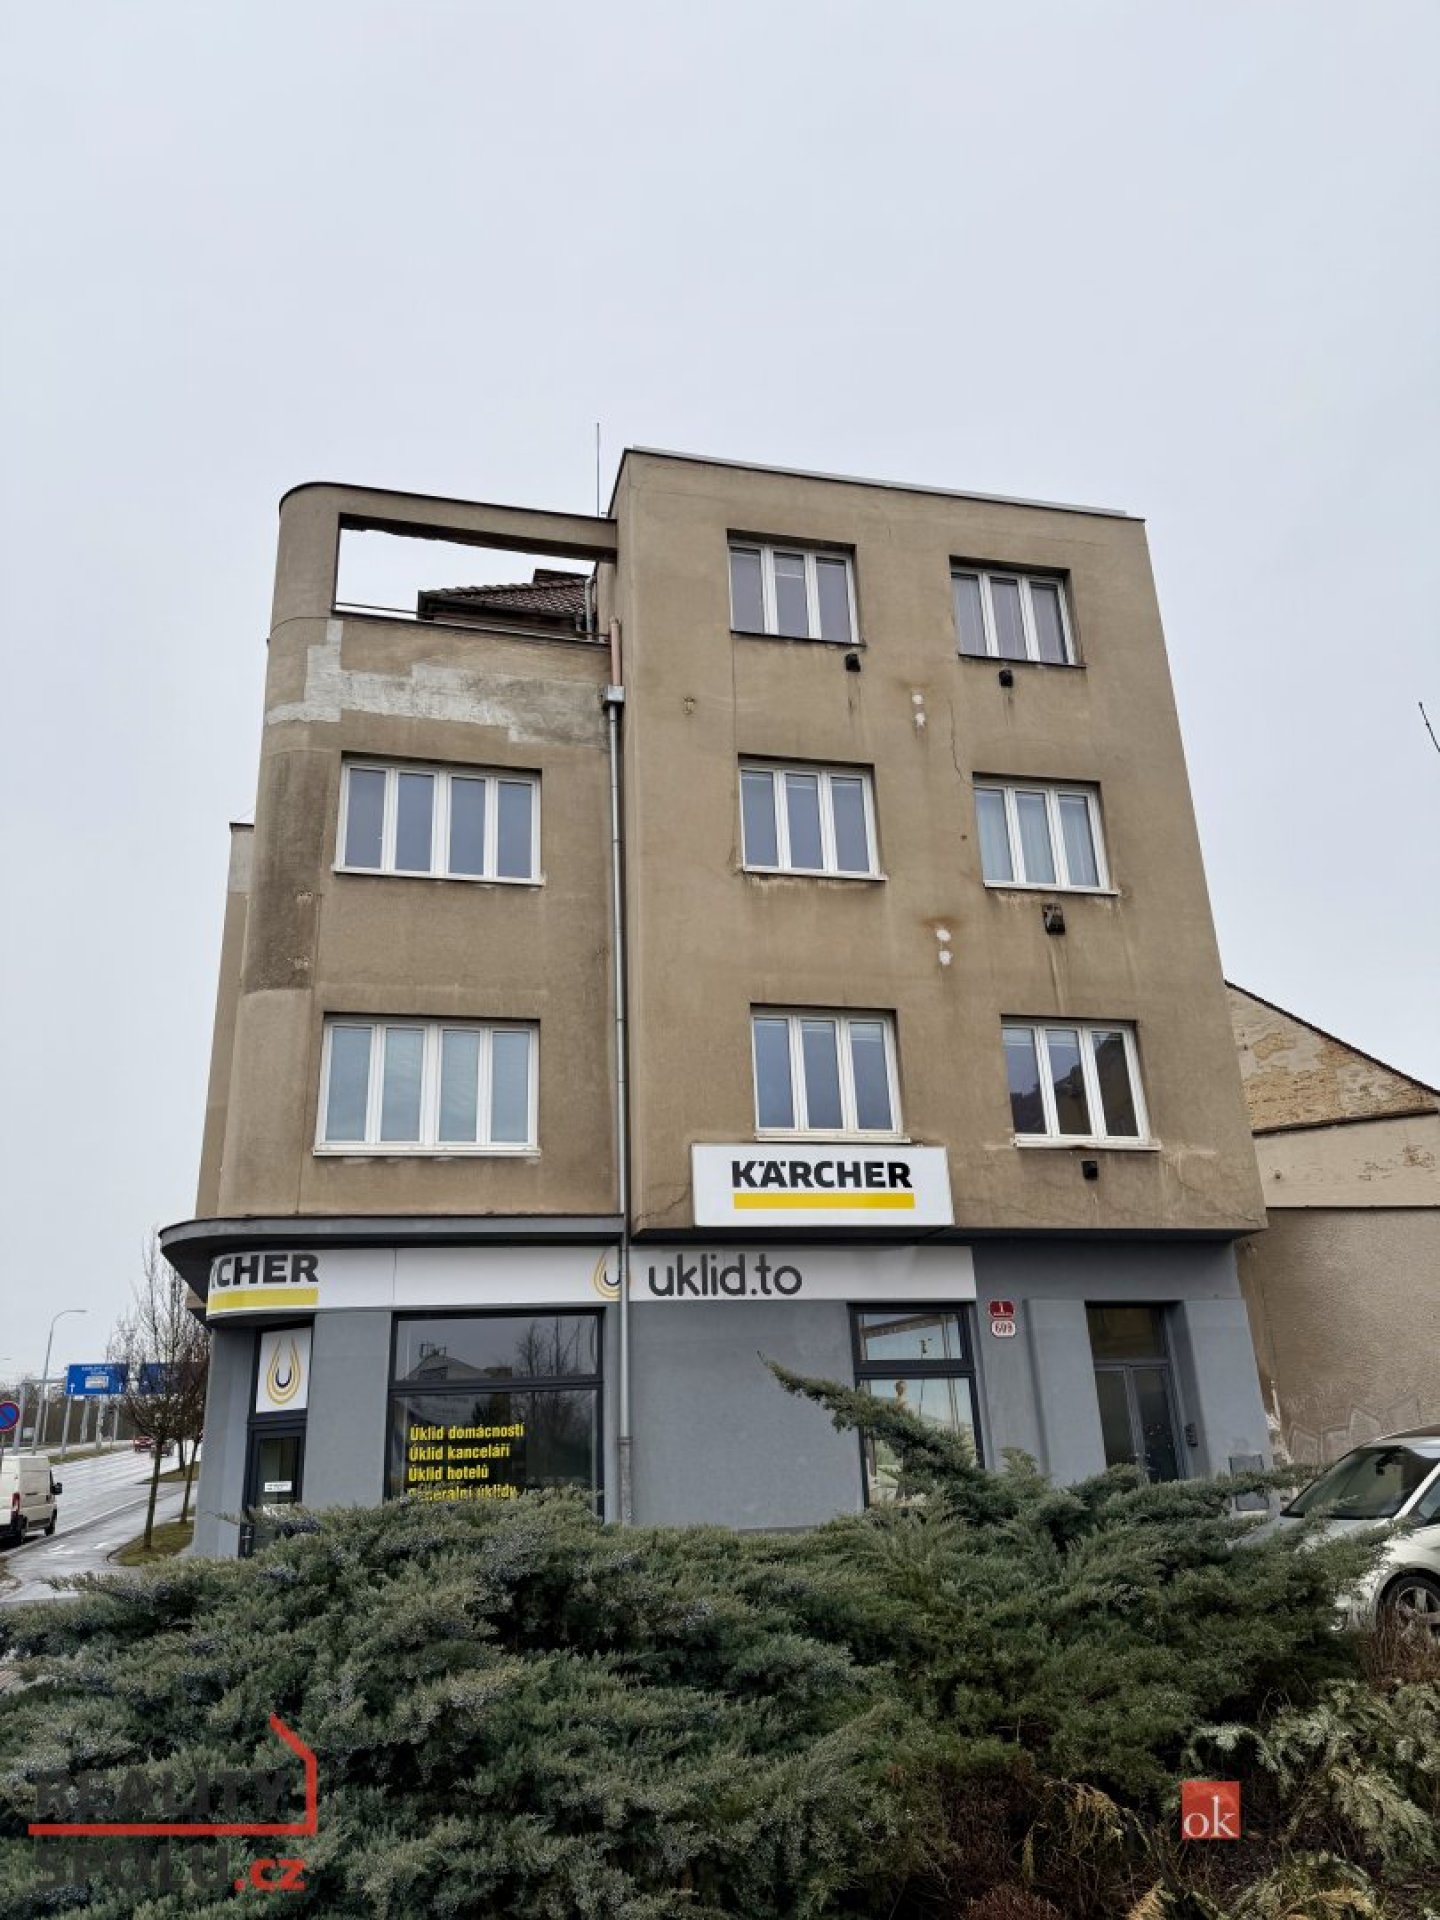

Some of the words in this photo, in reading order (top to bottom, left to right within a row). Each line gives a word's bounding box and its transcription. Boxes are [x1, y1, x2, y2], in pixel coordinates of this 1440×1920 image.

[731, 1160, 913, 1188] KÄRCHER
[648, 1253, 803, 1297] uklid.to
[410, 1423, 444, 1440] Úklid
[409, 1443, 443, 1461] Úklid
[408, 1464, 443, 1481] Úklid
